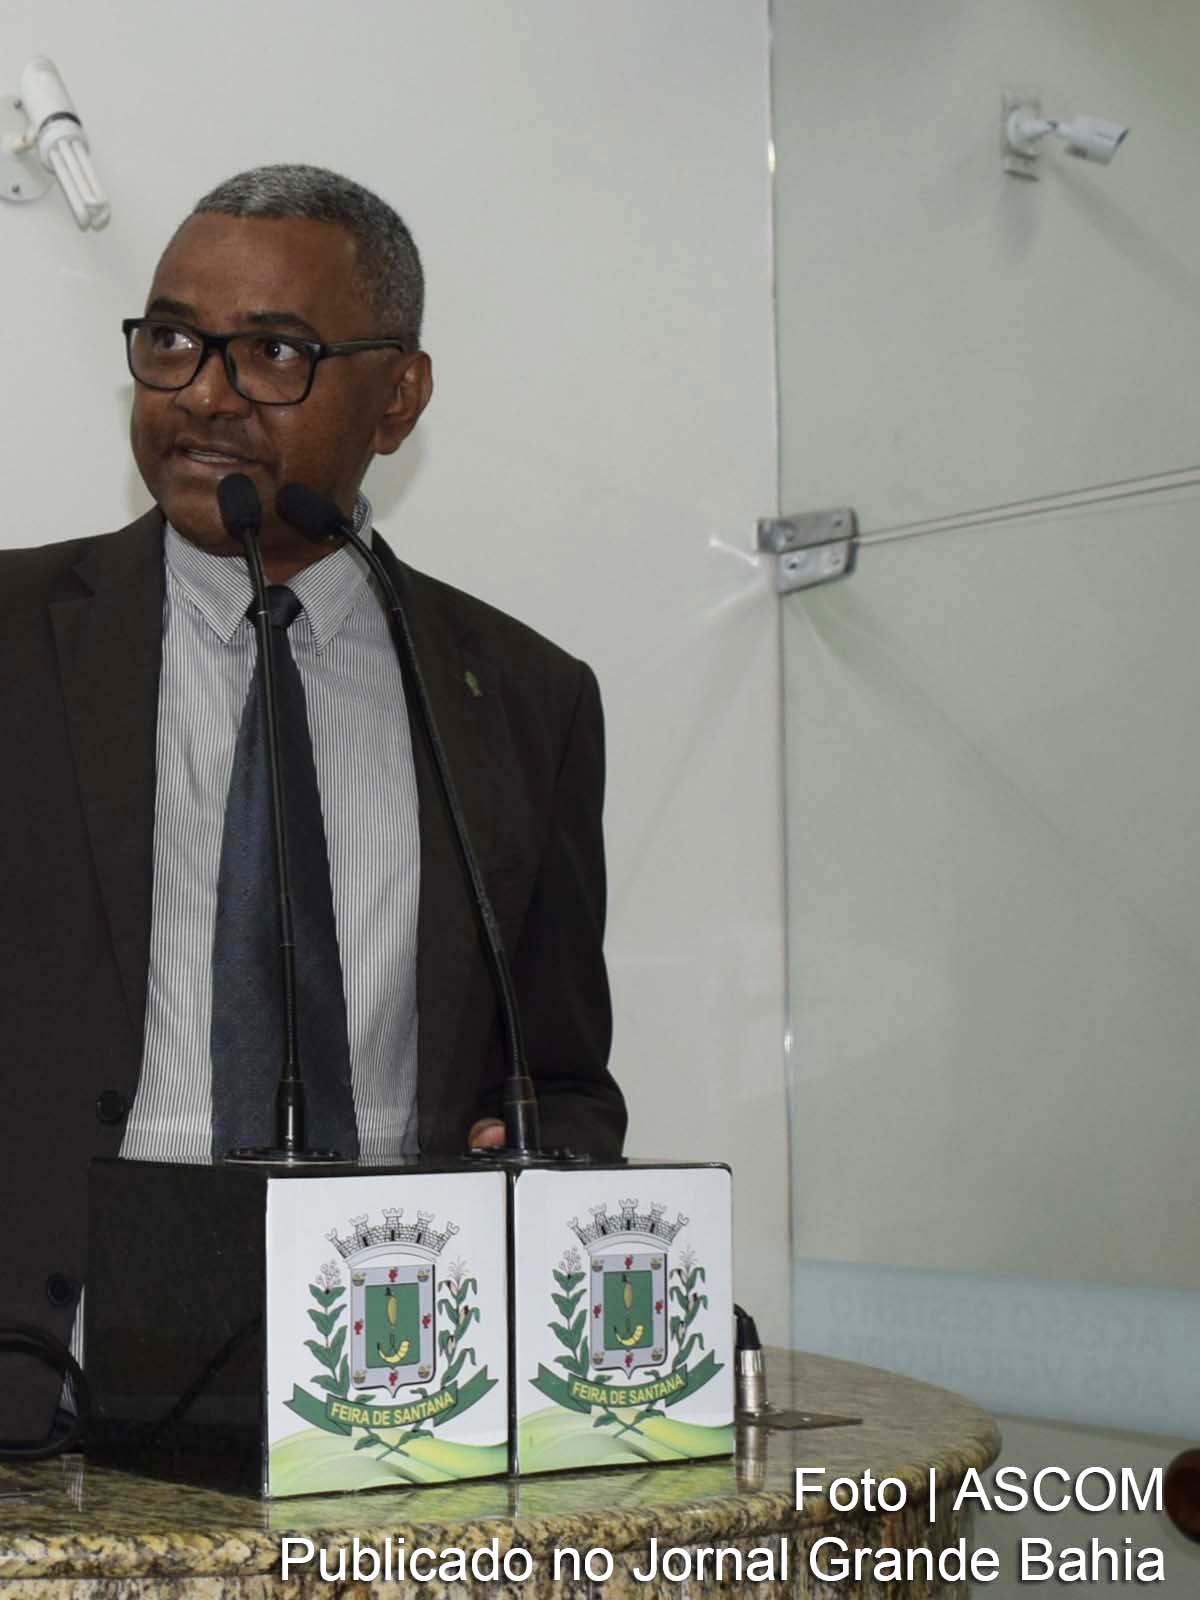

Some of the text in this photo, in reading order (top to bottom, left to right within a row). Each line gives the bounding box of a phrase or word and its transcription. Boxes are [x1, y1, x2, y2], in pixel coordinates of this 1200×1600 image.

[572, 1374, 685, 1404] FEIRA DE SANTANA
[331, 1391, 455, 1425] FEIRA DE SANTANA
